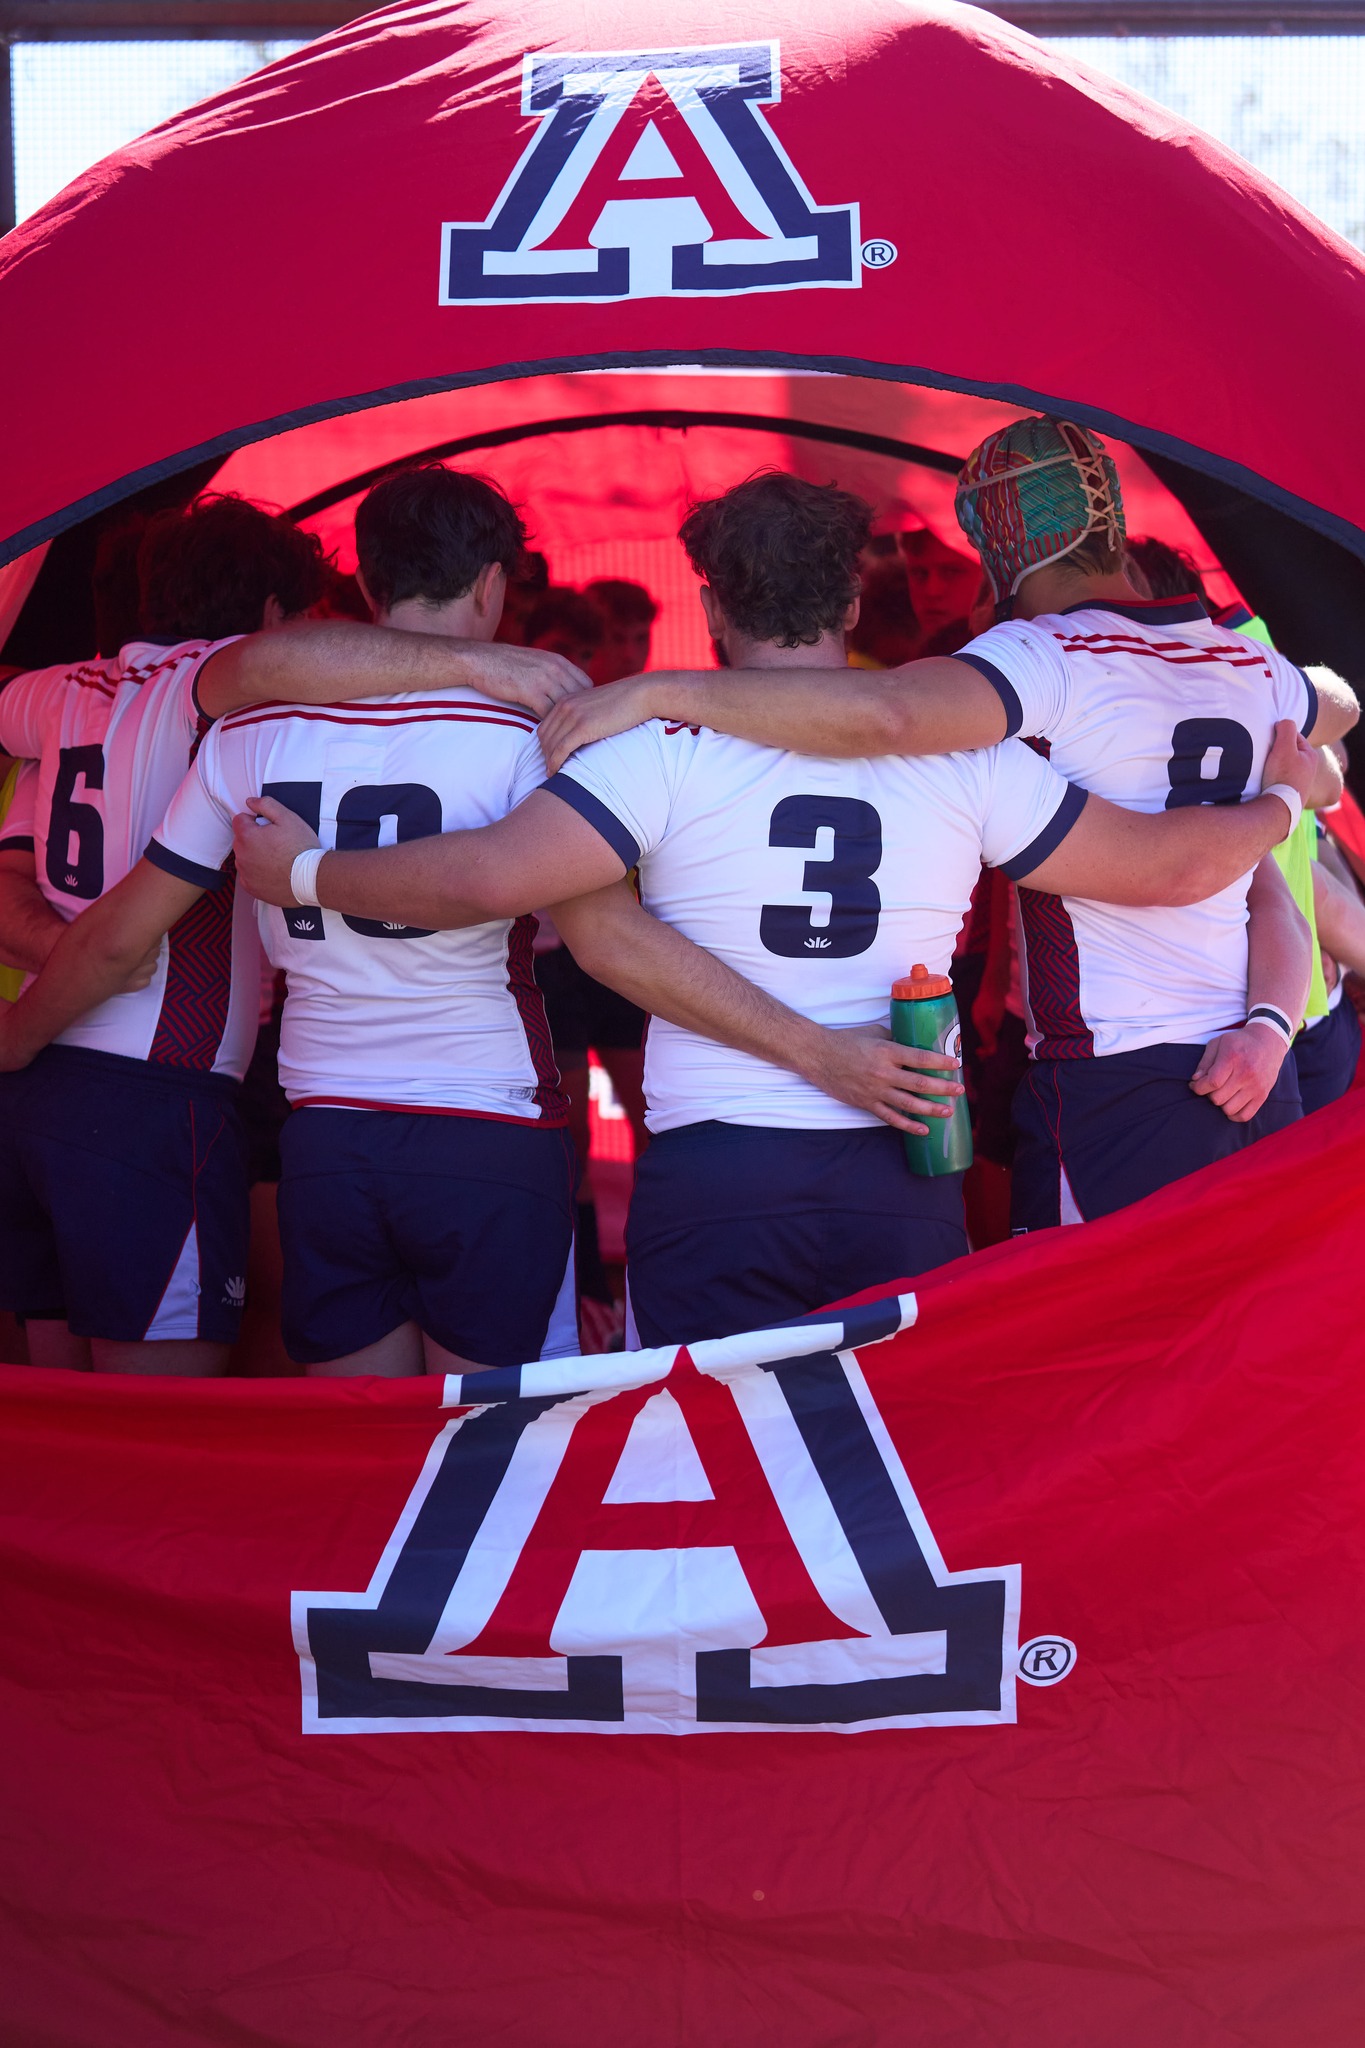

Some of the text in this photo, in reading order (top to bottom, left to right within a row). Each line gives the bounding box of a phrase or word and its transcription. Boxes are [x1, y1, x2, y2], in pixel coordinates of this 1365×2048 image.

[438, 39, 862, 306] A
[46, 743, 104, 899] 6
[759, 794, 883, 959] 3
[291, 1292, 1022, 1736] A
